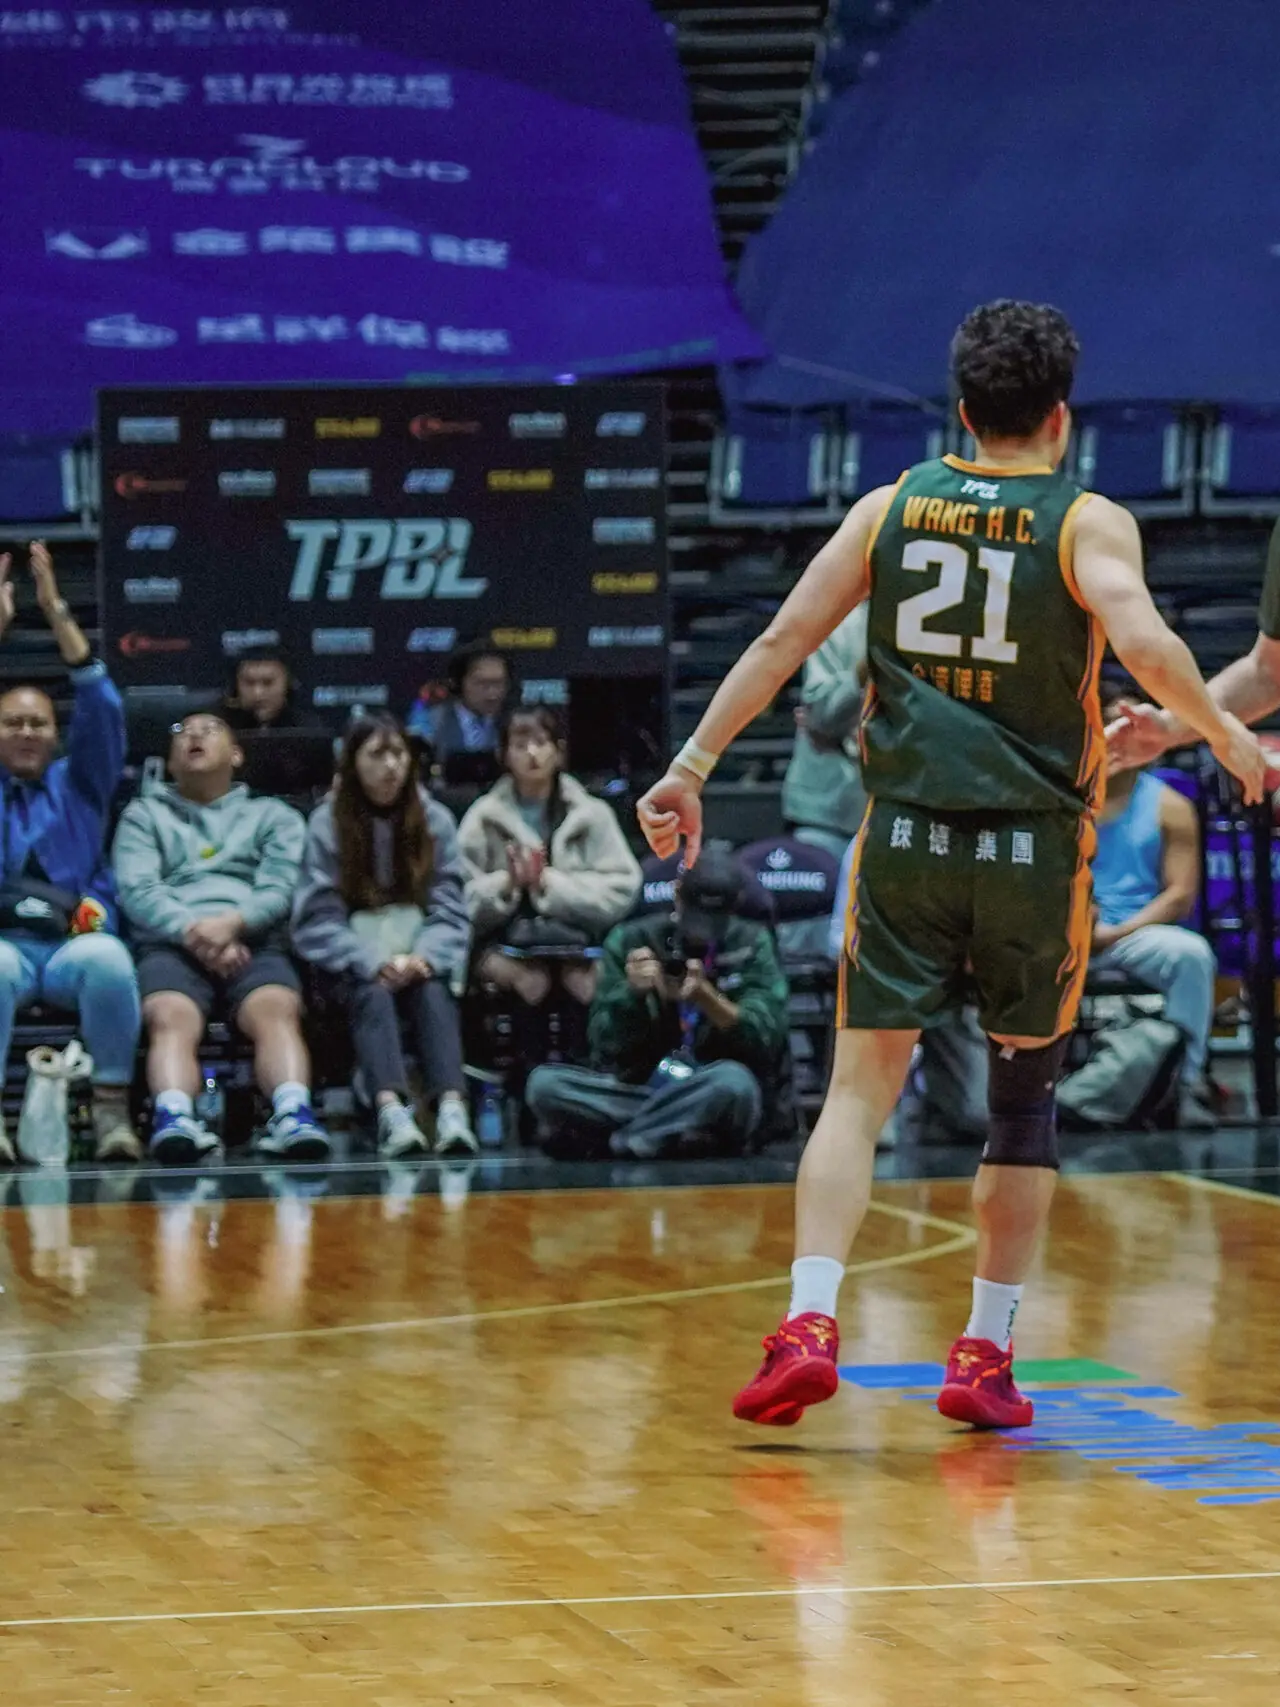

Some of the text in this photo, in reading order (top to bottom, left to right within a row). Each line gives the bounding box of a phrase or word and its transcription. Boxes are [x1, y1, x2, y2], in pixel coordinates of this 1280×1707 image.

[902, 496, 980, 536] WANG
[960, 479, 1000, 500] TPBL
[285, 517, 490, 601] TPBL
[896, 539, 1019, 664] 21
